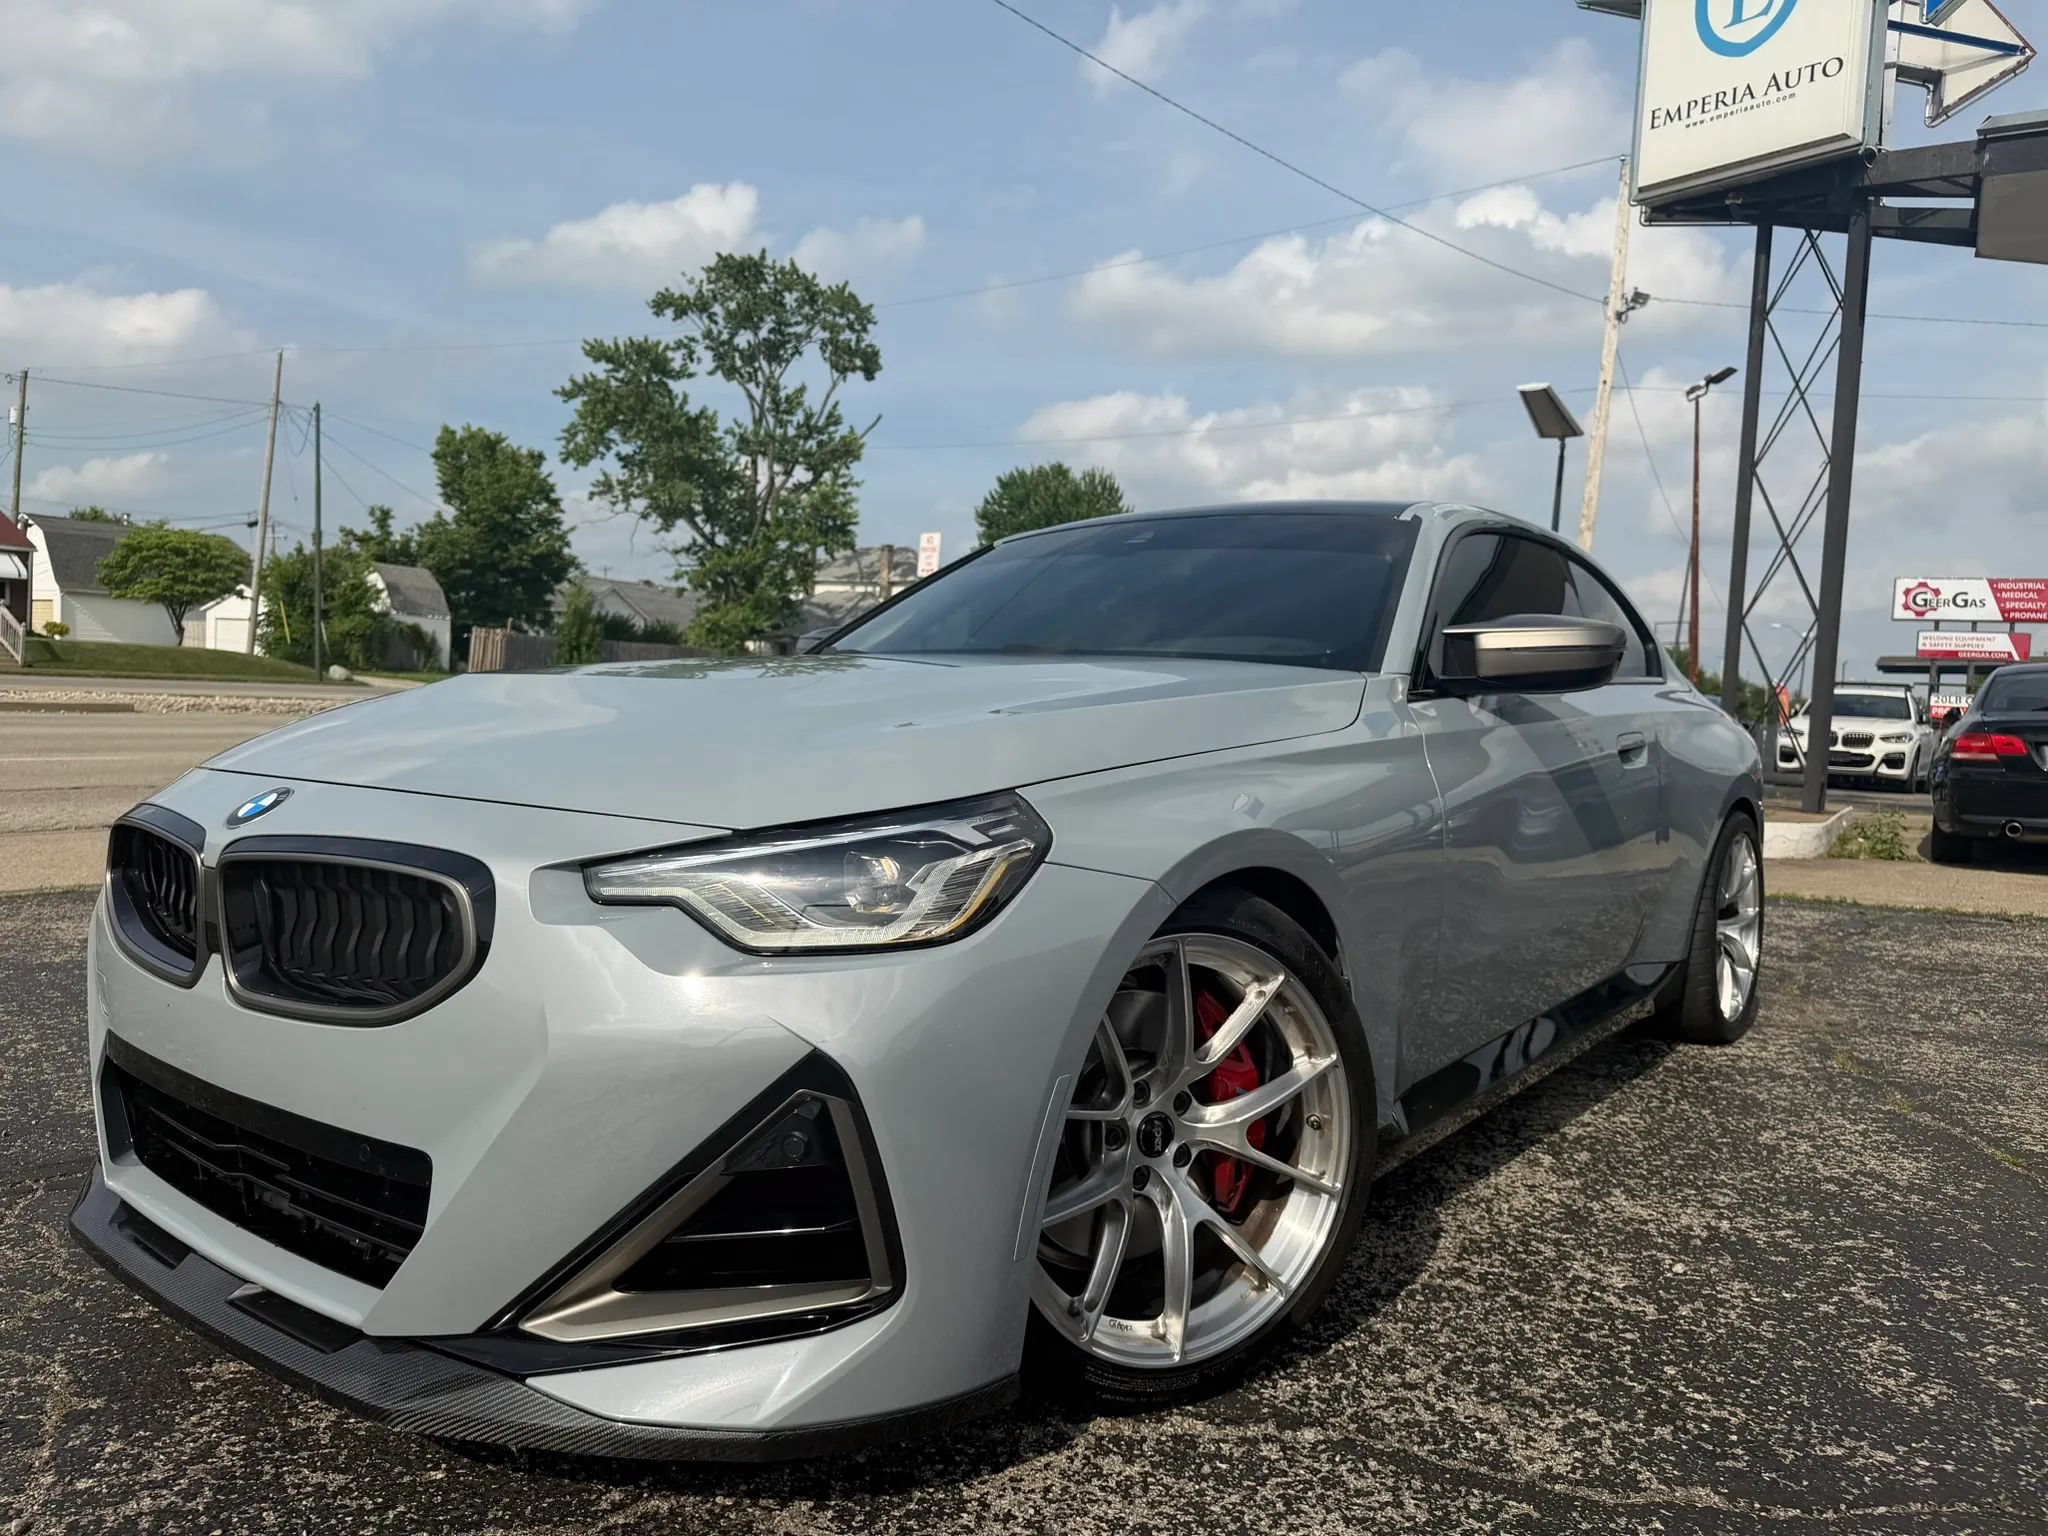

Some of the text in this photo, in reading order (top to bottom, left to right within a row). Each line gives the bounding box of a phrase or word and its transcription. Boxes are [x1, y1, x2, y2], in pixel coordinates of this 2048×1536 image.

[1650, 57, 1844, 130] EMPERIA AUTO
[1685, 92, 1796, 129] www.emperiaauto.com
[1998, 582, 2046, 590] INDUSTRIAL
[2001, 591, 2038, 599] MEDICAL
[2005, 601, 2047, 609] SPECIALTY
[2010, 611, 2048, 620] PROPANE
[1958, 651, 2008, 659] GEERGAS.COM
